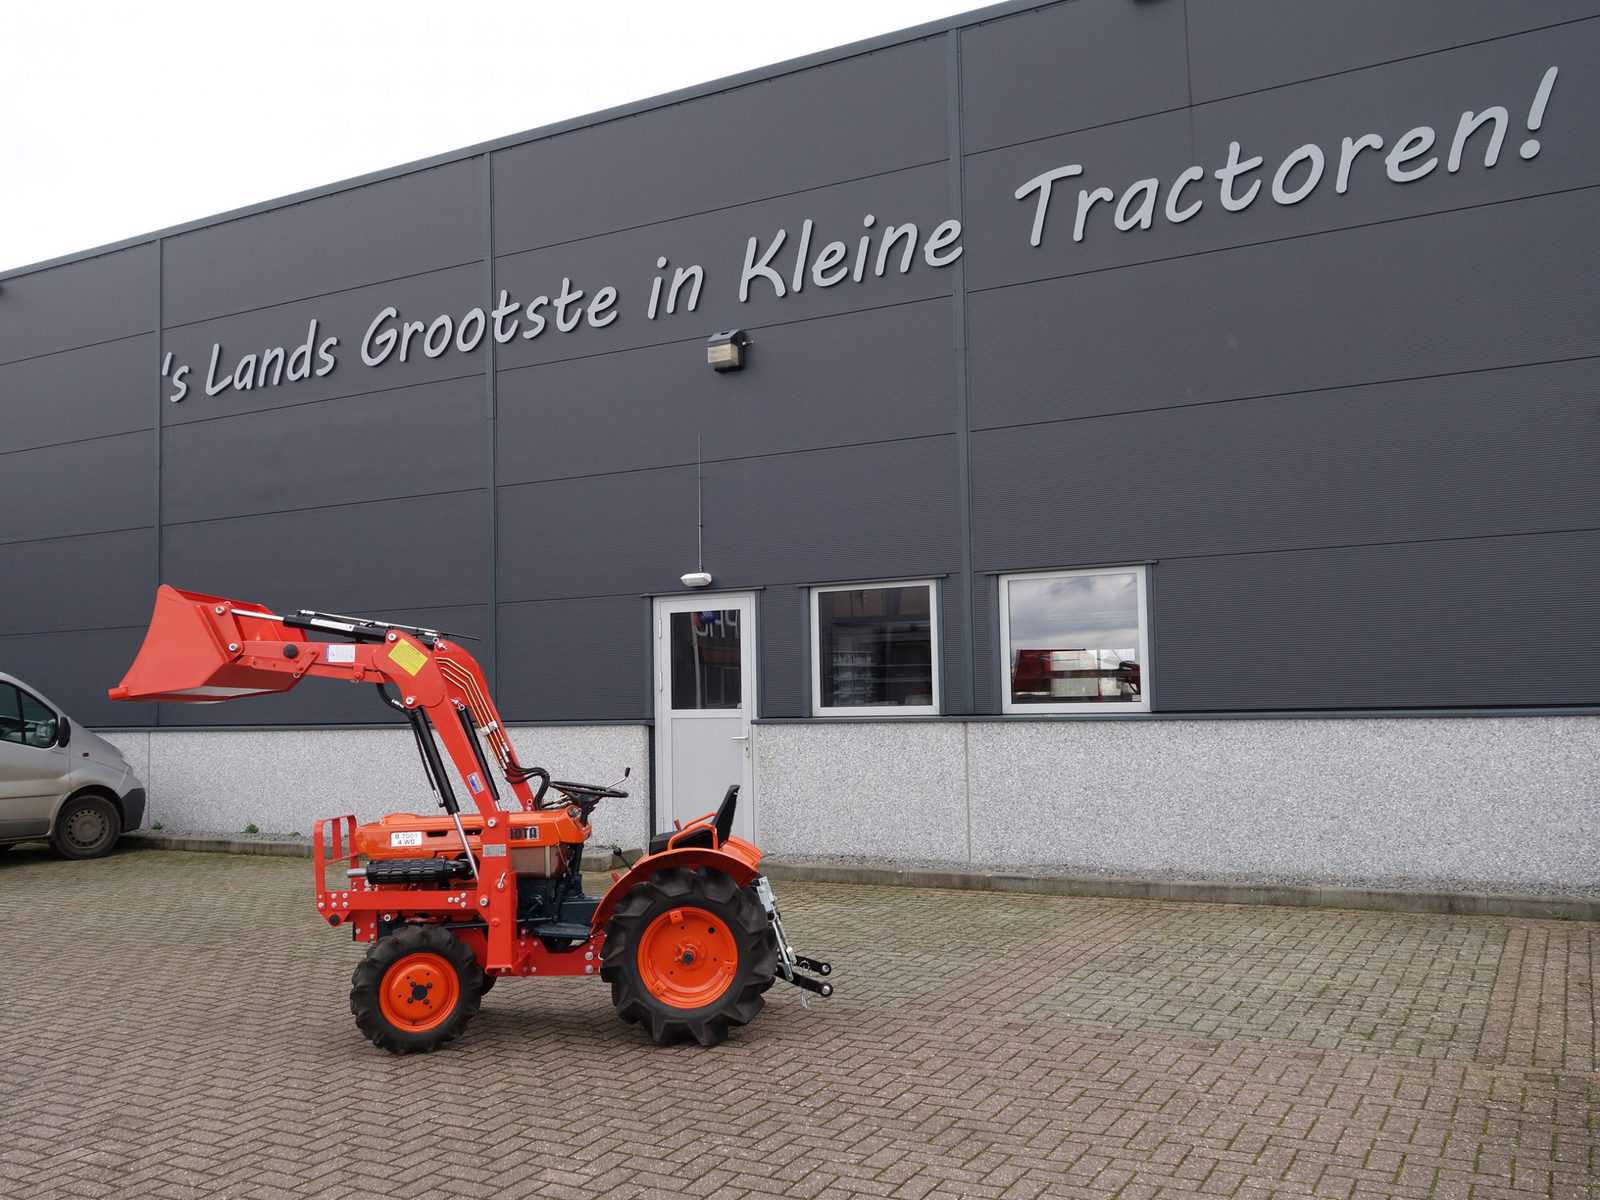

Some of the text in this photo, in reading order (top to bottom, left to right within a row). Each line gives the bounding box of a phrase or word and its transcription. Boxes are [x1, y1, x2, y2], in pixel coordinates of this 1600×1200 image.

[161, 66, 1560, 404] 's Lands Grootste in Kleine Tractoren!
